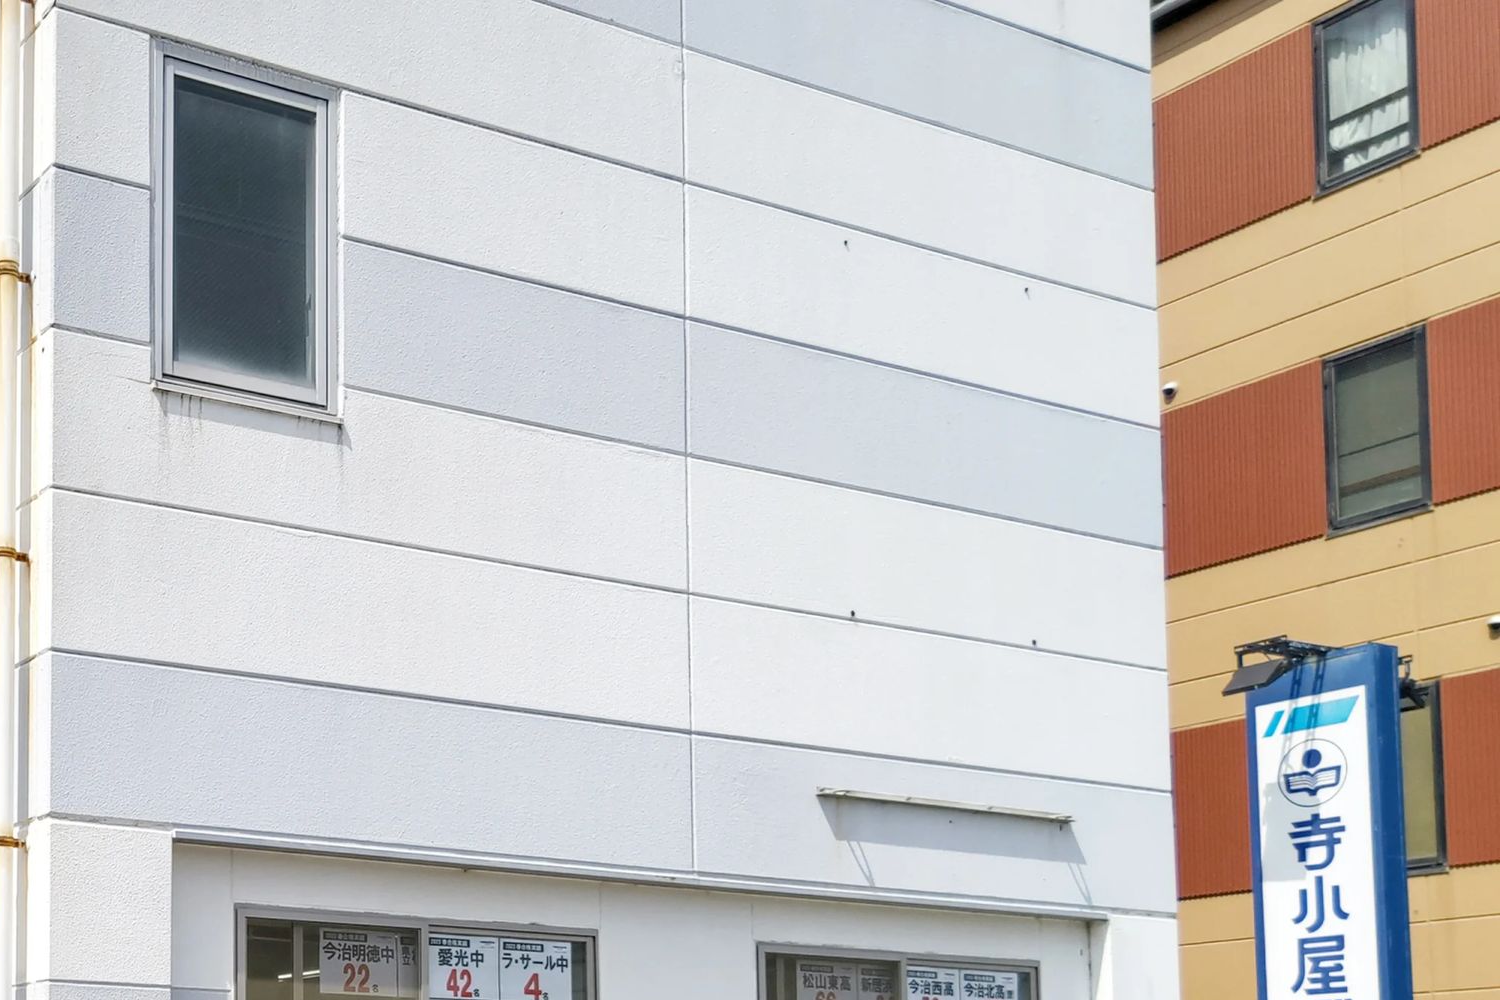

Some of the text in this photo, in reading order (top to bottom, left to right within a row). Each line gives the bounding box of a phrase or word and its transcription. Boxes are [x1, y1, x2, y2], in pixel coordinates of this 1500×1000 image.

[323, 942, 395, 964] 今治明徳中
[438, 949, 484, 968] 愛光中
[502, 952, 569, 973] ラ・サール中
[343, 963, 370, 993] 22
[446, 969, 473, 998] 42
[523, 973, 542, 1000] 4
[803, 972, 851, 991] 松山東高
[908, 979, 954, 996] 今治西高
[964, 983, 1005, 999] 今治北高
